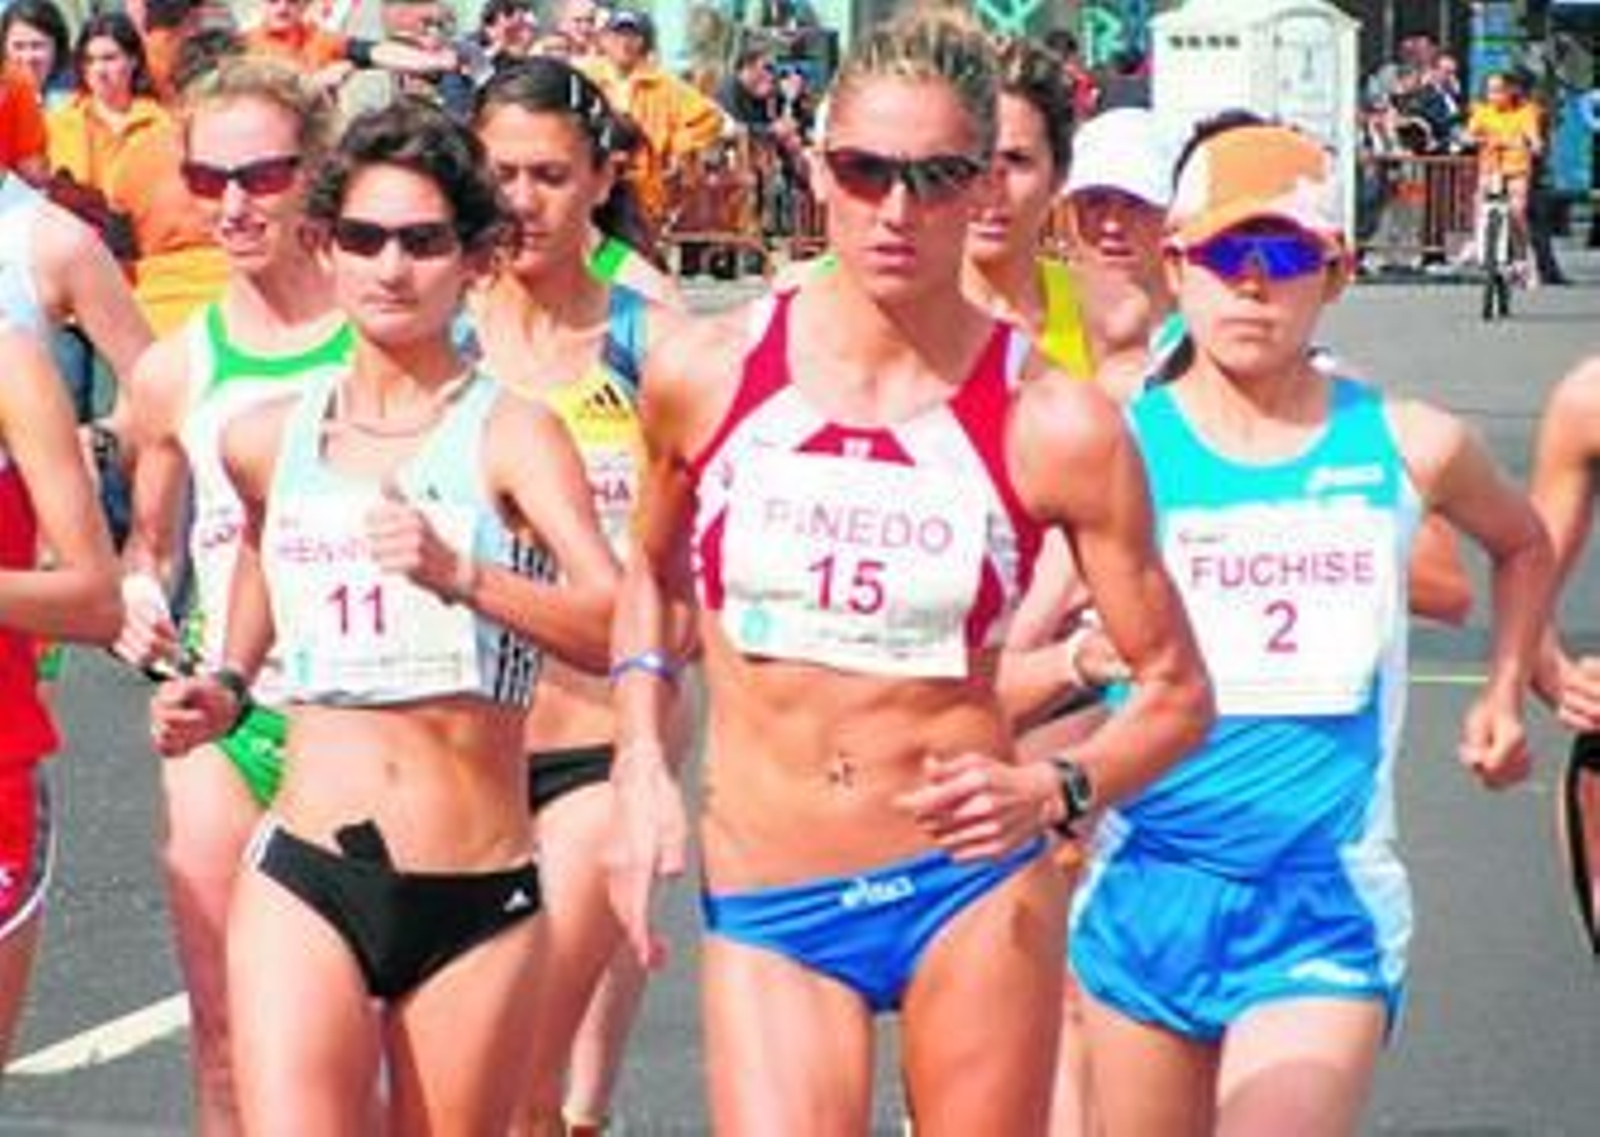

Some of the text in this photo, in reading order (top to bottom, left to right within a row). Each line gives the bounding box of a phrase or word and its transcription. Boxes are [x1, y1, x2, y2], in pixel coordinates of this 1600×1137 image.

[808, 555, 886, 615] 15
[1190, 550, 1376, 588] FUCHISE
[328, 584, 386, 635] 11
[1263, 599, 1299, 653] 2
